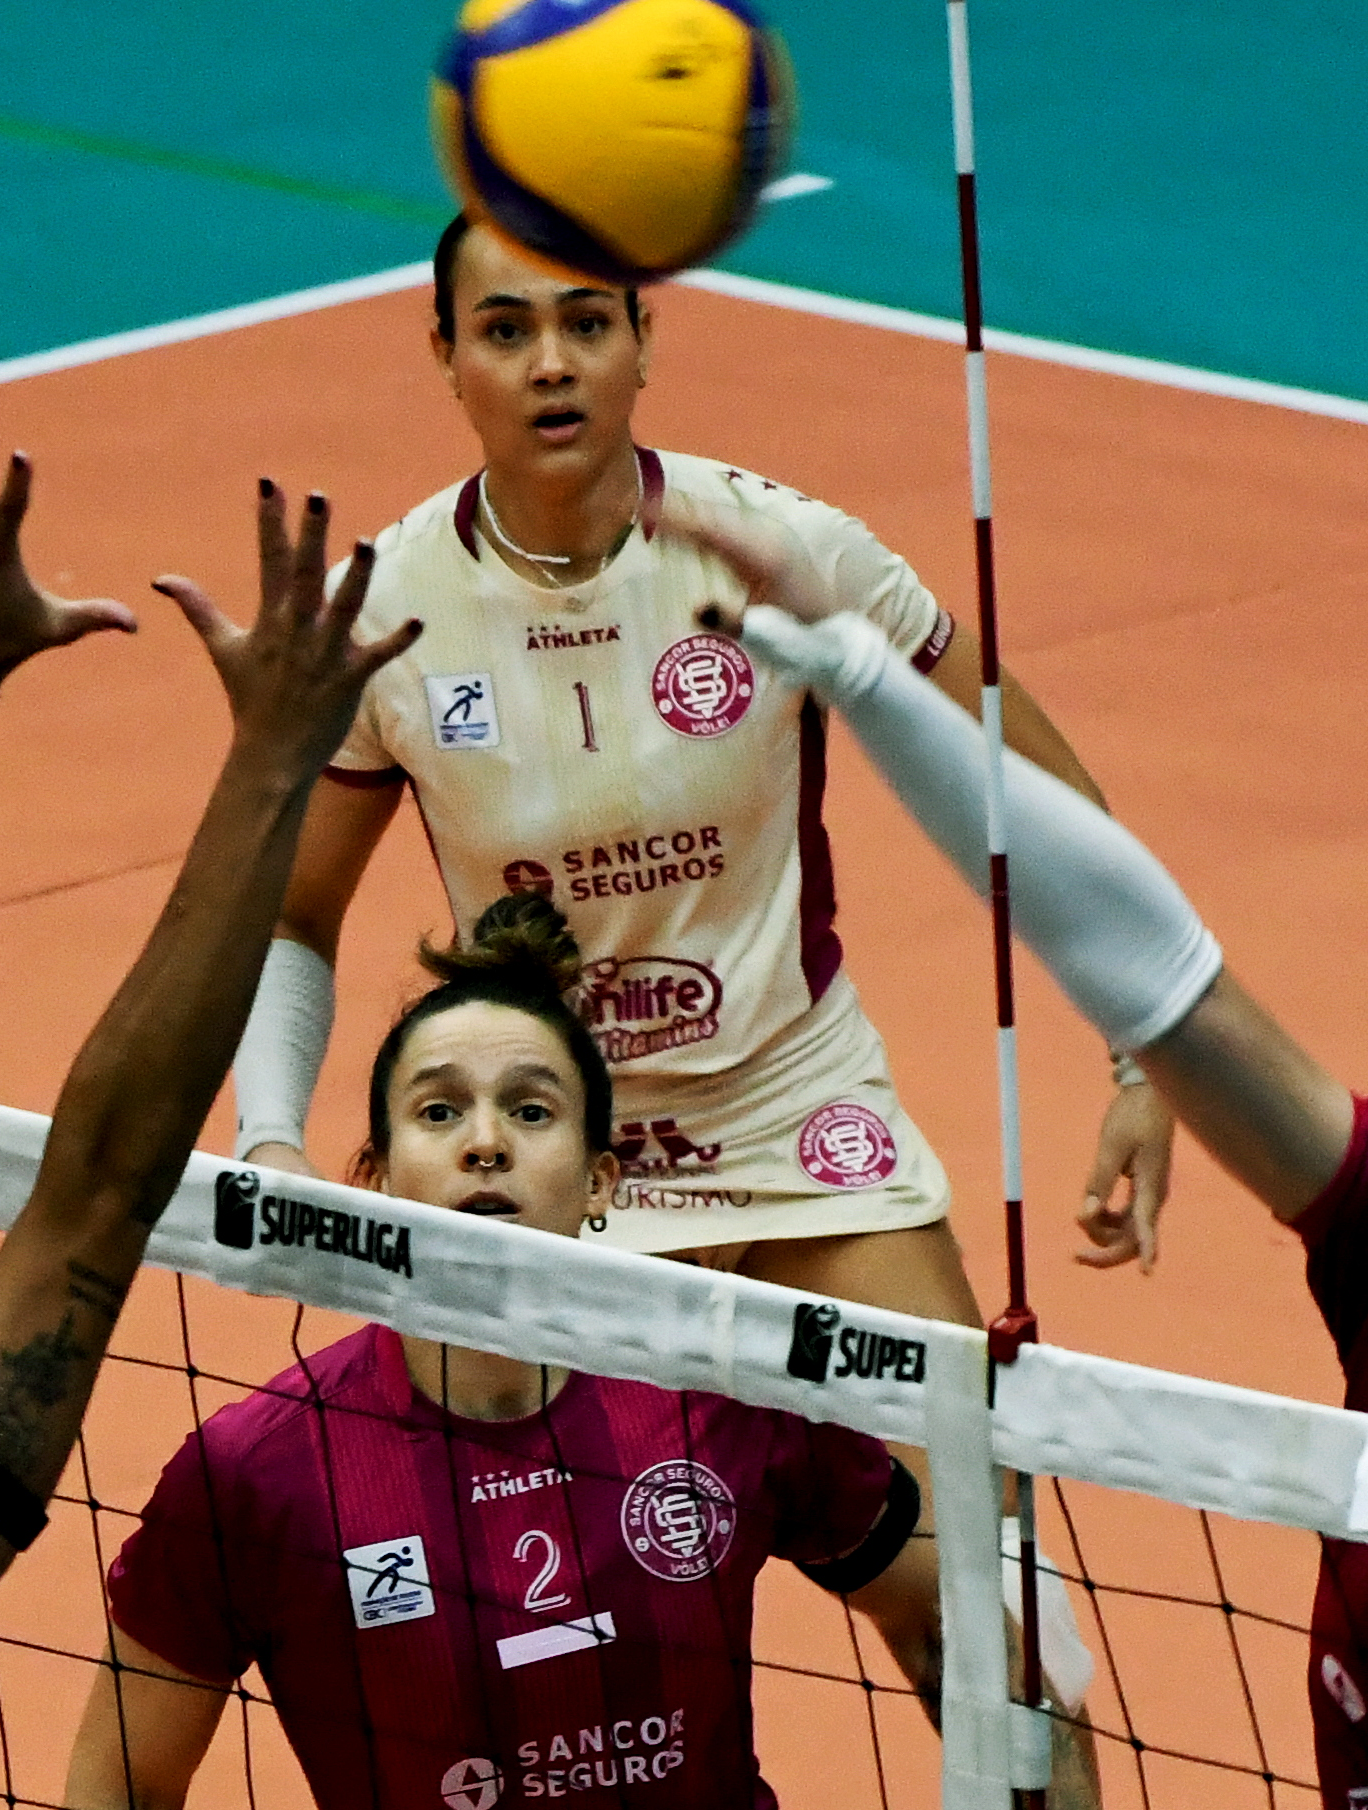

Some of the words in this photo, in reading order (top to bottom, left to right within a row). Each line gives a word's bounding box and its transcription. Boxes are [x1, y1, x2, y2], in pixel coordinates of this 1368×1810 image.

[526, 625, 620, 651] ATHLETA
[573, 681, 600, 752] 1
[563, 825, 723, 874] SANCOR
[569, 854, 725, 902] SEGUROS
[578, 974, 705, 1025] nilife
[259, 1195, 414, 1279] SUPERLIGA
[512, 1529, 572, 1613] 2
[517, 1707, 684, 1768] SANCOR
[521, 1739, 685, 1798] SEGUROS
